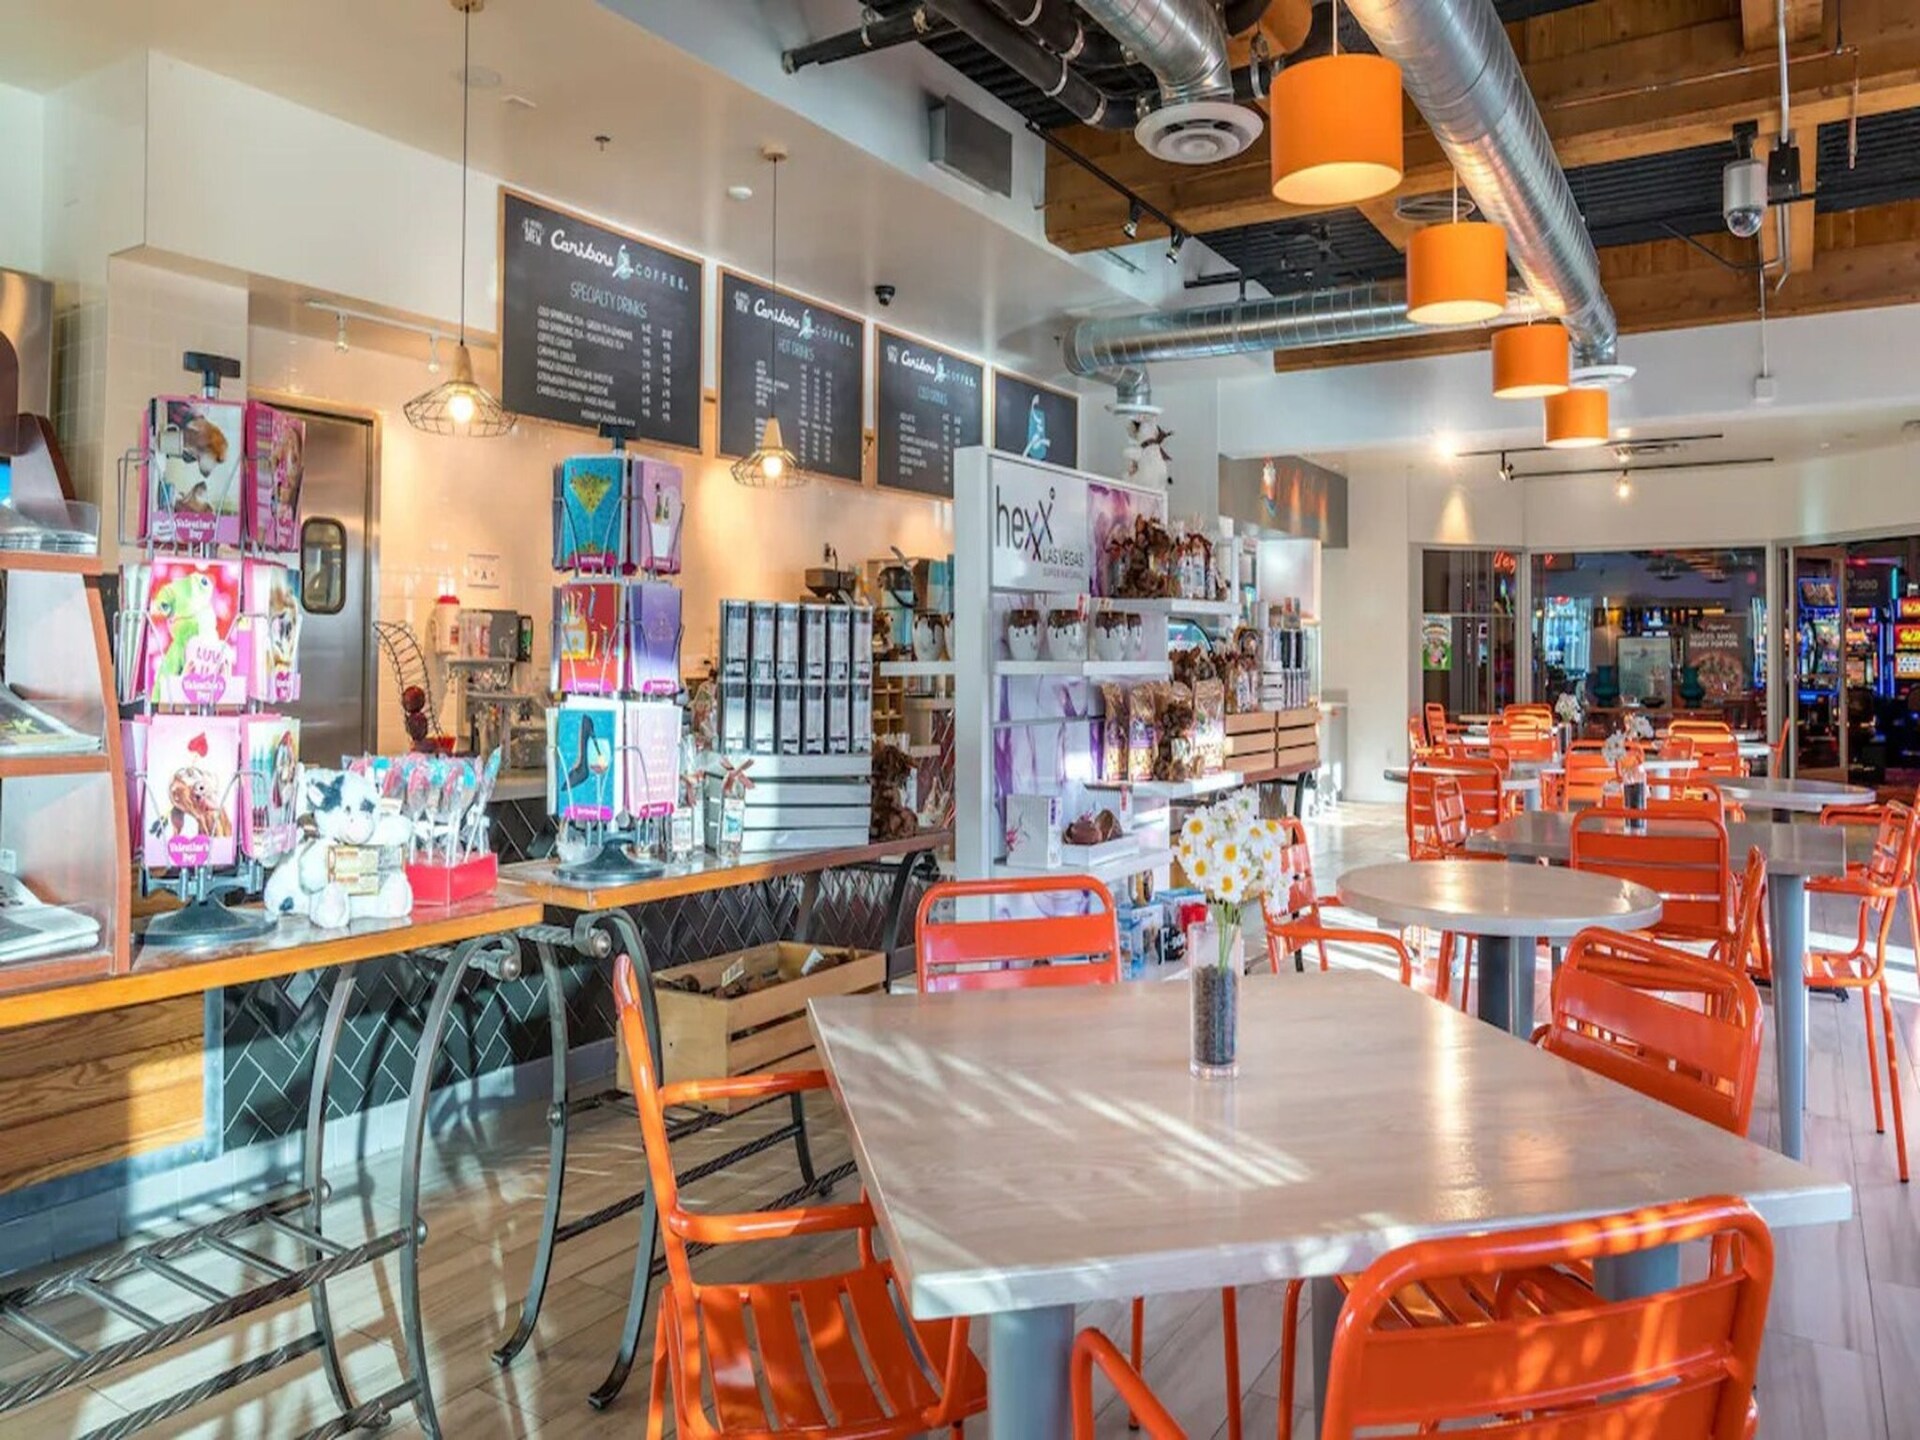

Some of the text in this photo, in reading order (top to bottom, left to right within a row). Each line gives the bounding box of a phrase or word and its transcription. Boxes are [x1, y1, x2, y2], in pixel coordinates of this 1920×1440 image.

[551, 229, 684, 292] Caribou COFFEE
[570, 281, 648, 319] SPECIALTY DRINKS
[754, 298, 801, 330] Caribou
[901, 349, 936, 375] Caribou
[174, 518, 217, 530] Valentine's
[1042, 548, 1085, 568] LAS VEGAS
[168, 841, 210, 854] Valentine's
